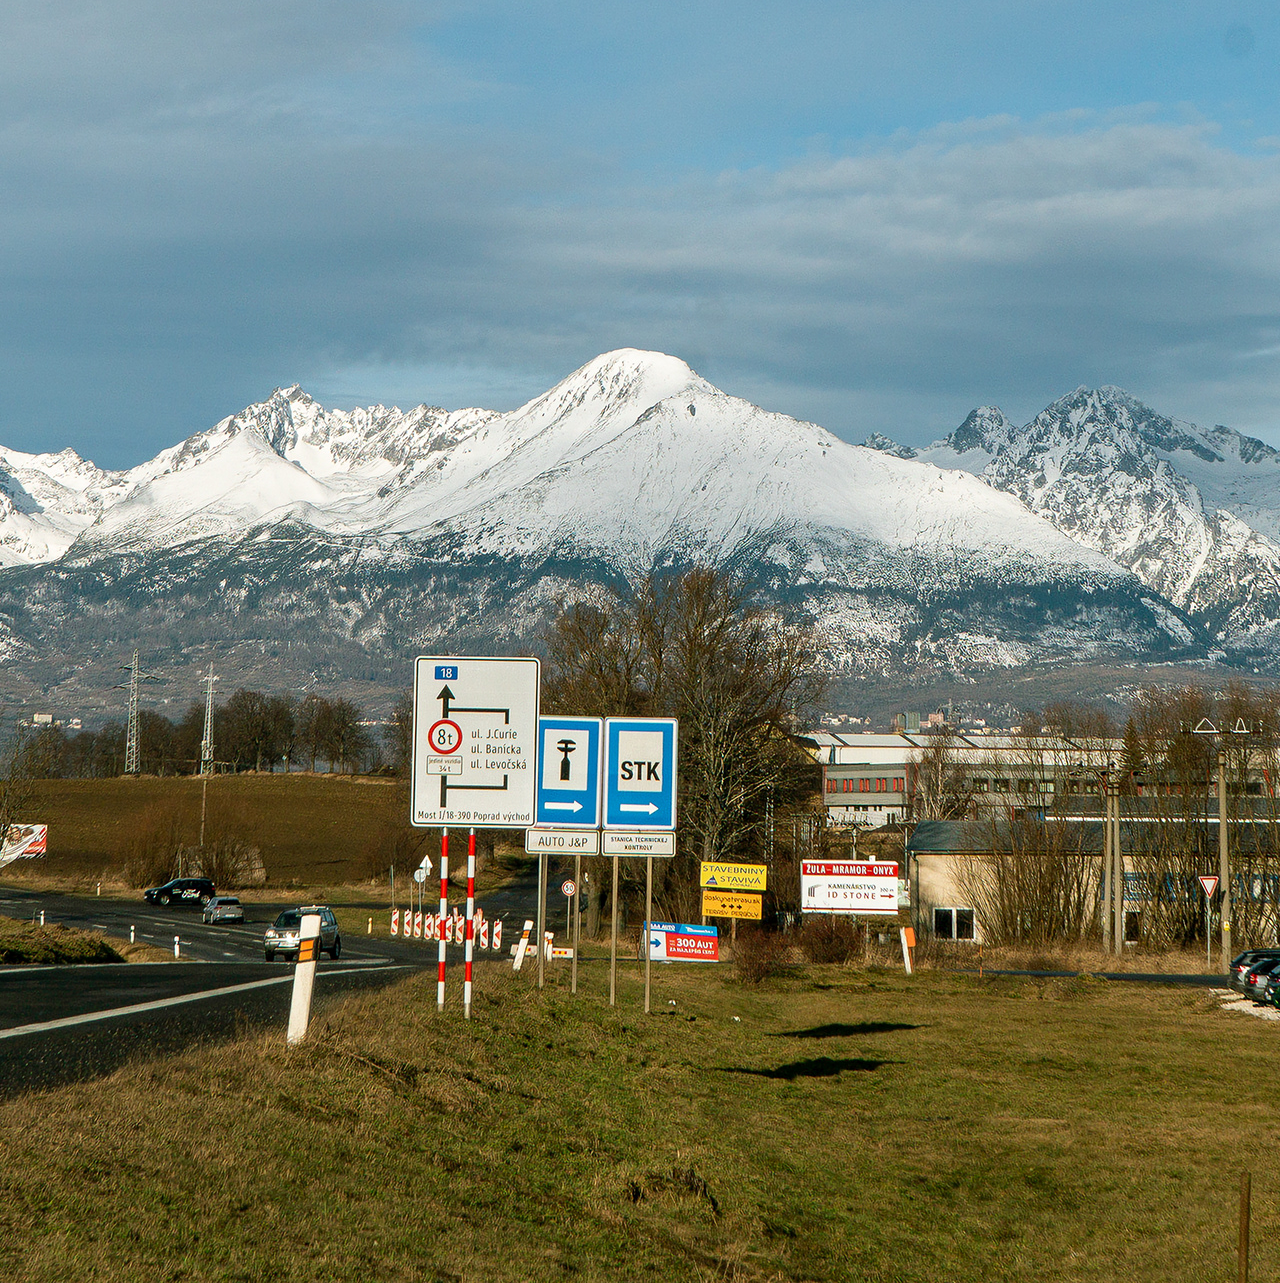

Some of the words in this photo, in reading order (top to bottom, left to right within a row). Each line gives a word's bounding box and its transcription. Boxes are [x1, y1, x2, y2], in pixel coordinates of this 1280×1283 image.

[440, 668, 453, 678] 18
[472, 730, 482, 739] ul.
[486, 729, 518, 739] J.Curie
[471, 744, 482, 754] ul.
[470, 759, 482, 768] ul.
[486, 758, 527, 770] Levočská
[620, 761, 661, 781] STK
[418, 810, 437, 819] Most
[474, 812, 500, 821] Poprad
[502, 812, 530, 822] východ
[538, 836, 564, 847] AUTO
[568, 838, 588, 848] J&P
[703, 865, 765, 875] STAVEBNINY
[832, 865, 867, 874] MRAMOR
[872, 866, 894, 876] ONYX
[565, 884, 573, 892] 50
[844, 892, 876, 900] STONE
[676, 938, 696, 948] 300
[696, 940, 714, 949] AUT
